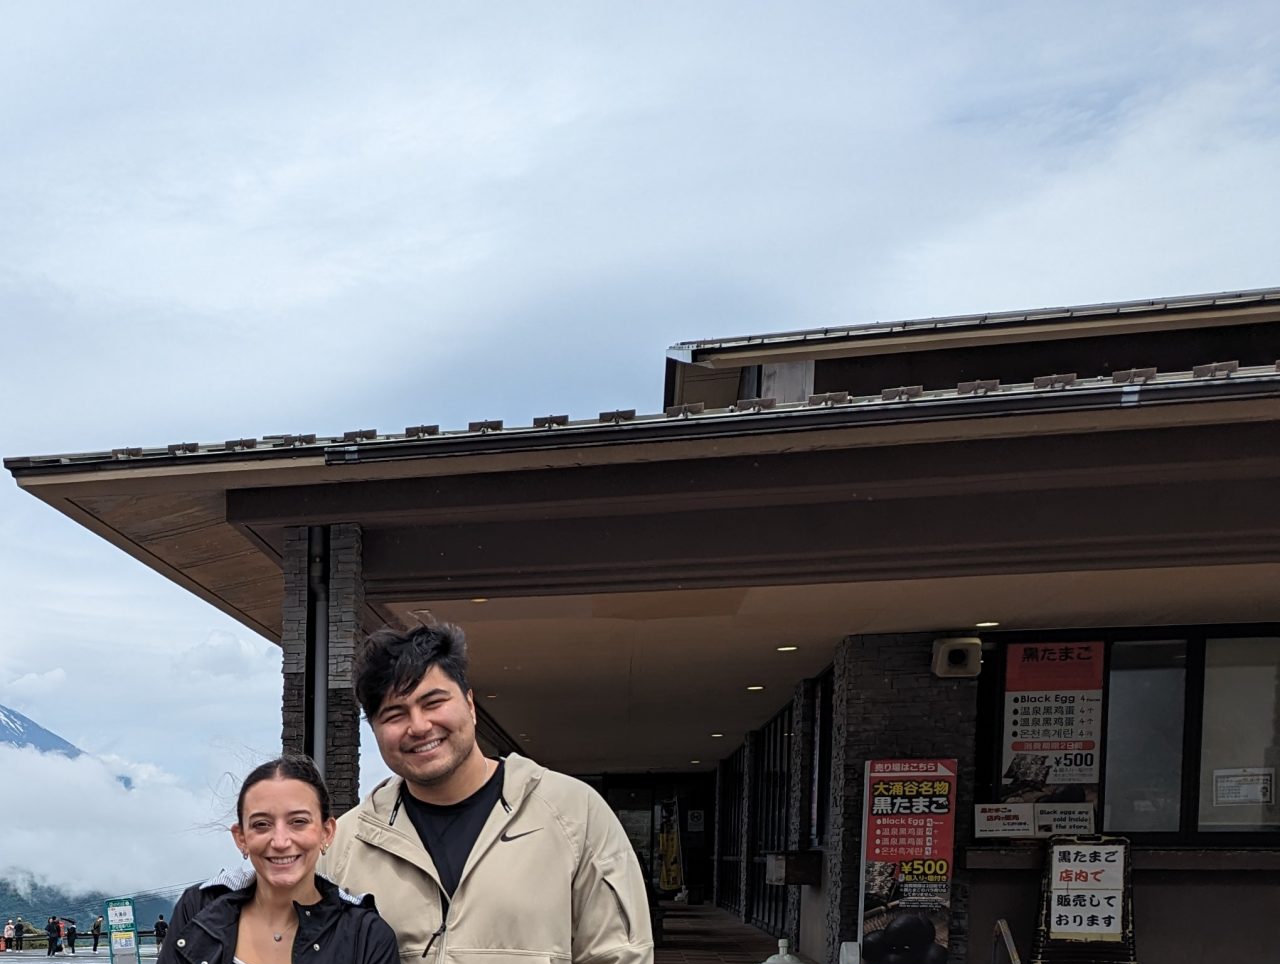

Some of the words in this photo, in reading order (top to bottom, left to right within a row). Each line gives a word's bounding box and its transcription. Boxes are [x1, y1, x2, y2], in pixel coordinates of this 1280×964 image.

[1022, 646, 1093, 662] 黒たまご
[1020, 694, 1051, 703] Black
[1055, 694, 1075, 704] Egg
[1054, 753, 1094, 767] ¥500
[874, 763, 936, 772] 売り場はこちら
[873, 781, 950, 796] 大涌谷名物
[872, 796, 949, 814] 黒たまご
[882, 817, 906, 825] Black
[908, 818, 925, 826] Egg
[1058, 851, 1118, 863] 黒たまご
[901, 860, 948, 874] ¥500
[1059, 869, 1105, 882] 店内で
[1056, 894, 1117, 908] 販売して
[1055, 914, 1116, 927] おります
